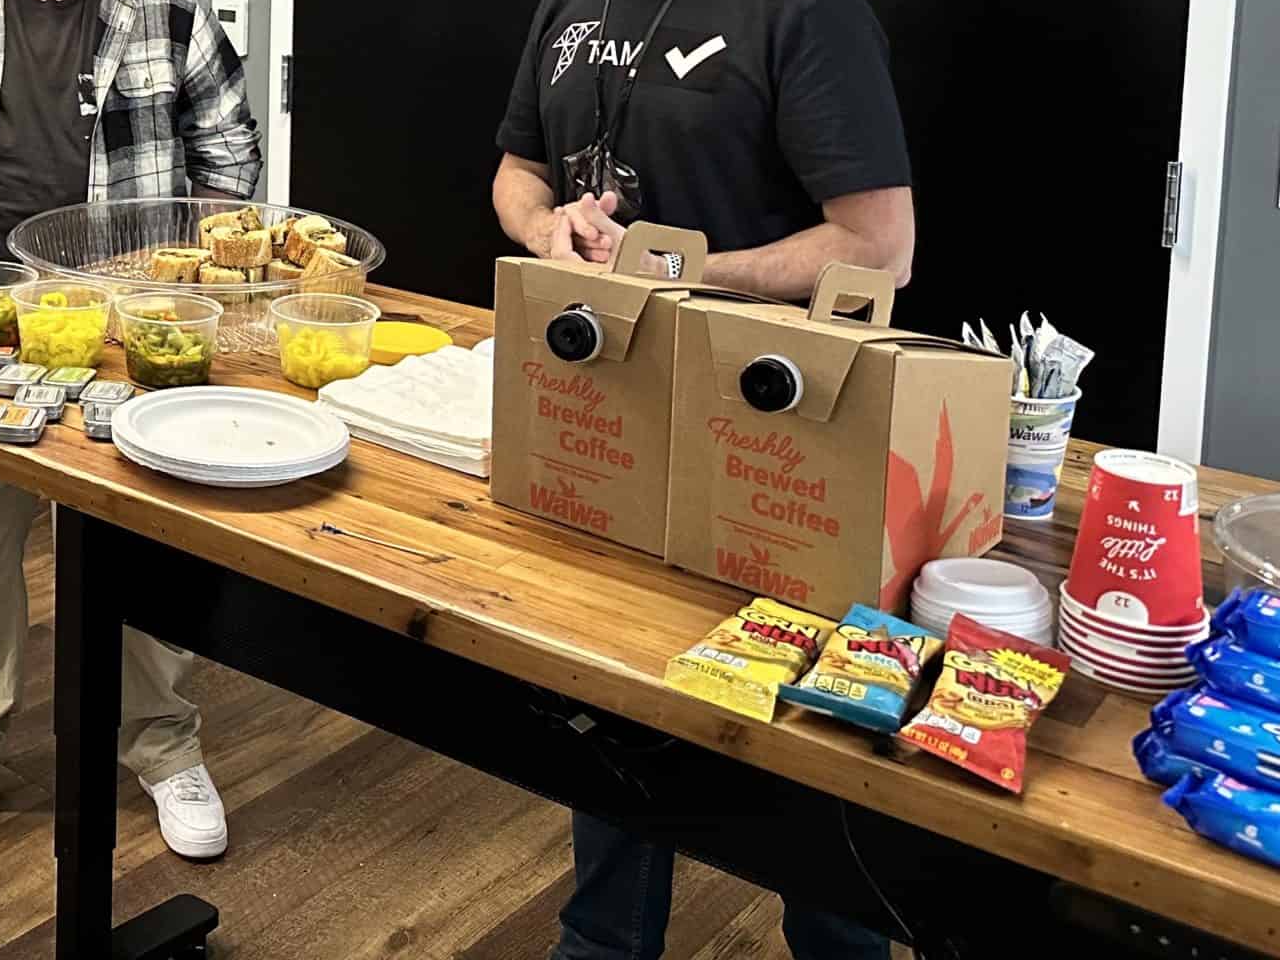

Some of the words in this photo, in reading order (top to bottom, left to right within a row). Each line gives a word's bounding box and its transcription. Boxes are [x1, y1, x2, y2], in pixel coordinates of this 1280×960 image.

[522, 362, 607, 412] Freshly
[537, 396, 623, 438] Brewed
[1009, 427, 1052, 442] Wawa
[559, 431, 634, 470] Coffee
[706, 416, 806, 473] Freshly
[725, 454, 826, 502] Brewed
[1164, 490, 1179, 501] 12
[529, 481, 609, 532] Wawa
[751, 492, 840, 537] Coffee
[1107, 514, 1157, 535] THINGS
[1099, 558, 1125, 577] THE
[1101, 537, 1166, 562] Little
[716, 547, 809, 603] Wawa
[1131, 568, 1157, 580] IT'S
[1114, 596, 1131, 608] 12
